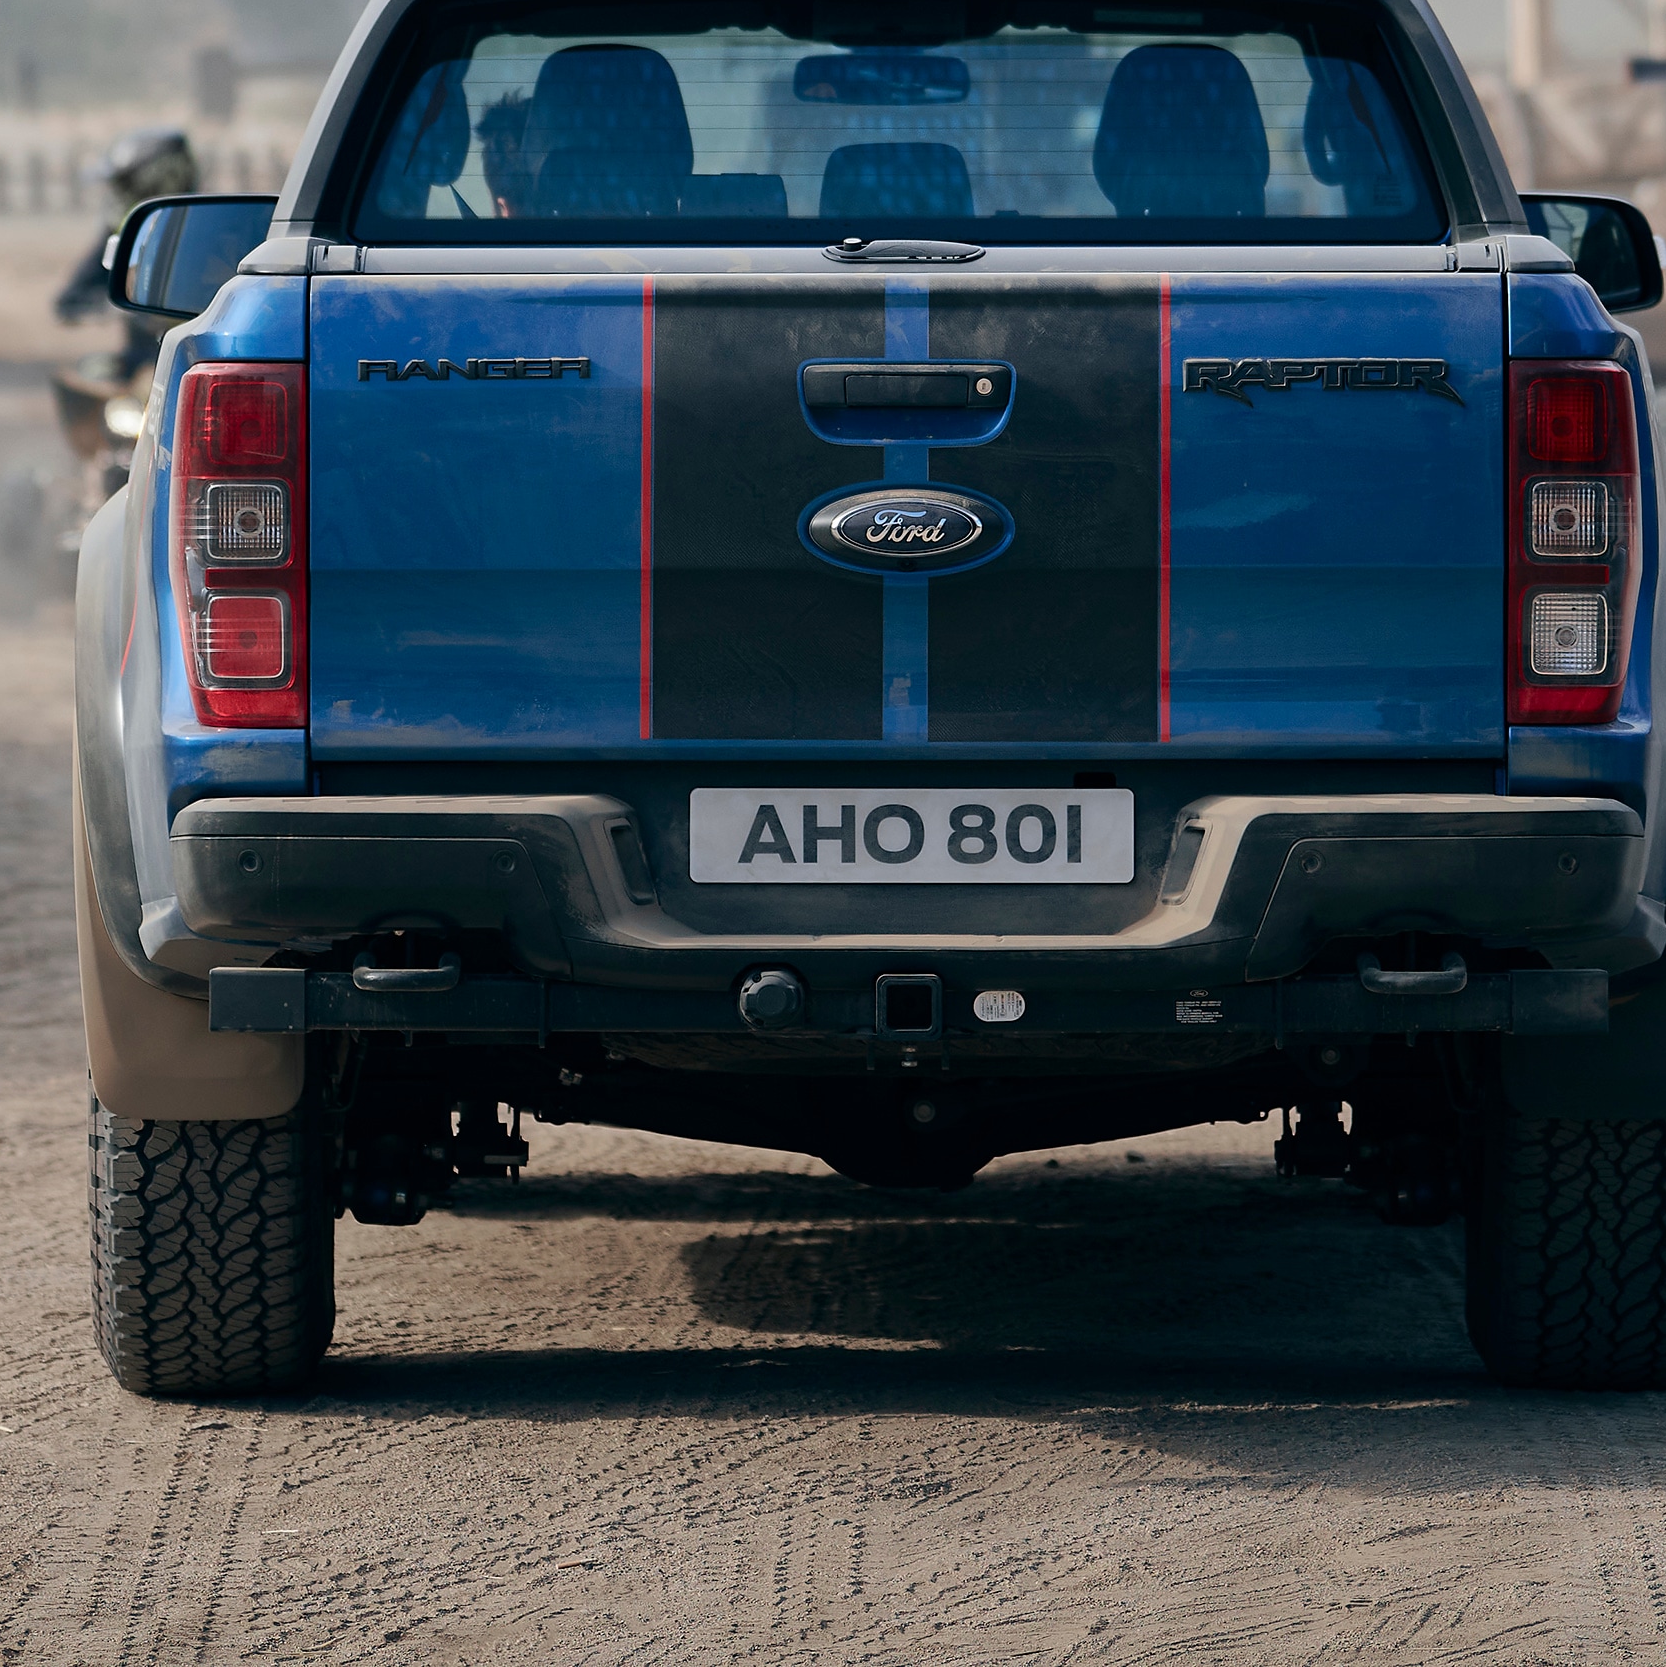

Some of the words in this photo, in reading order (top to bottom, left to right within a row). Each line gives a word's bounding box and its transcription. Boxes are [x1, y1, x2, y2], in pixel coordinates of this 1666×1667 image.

[357, 357, 592, 382] RANGER
[1182, 357, 1466, 409] RAPTOR
[865, 509, 947, 543] Ford
[737, 803, 925, 865] AHO
